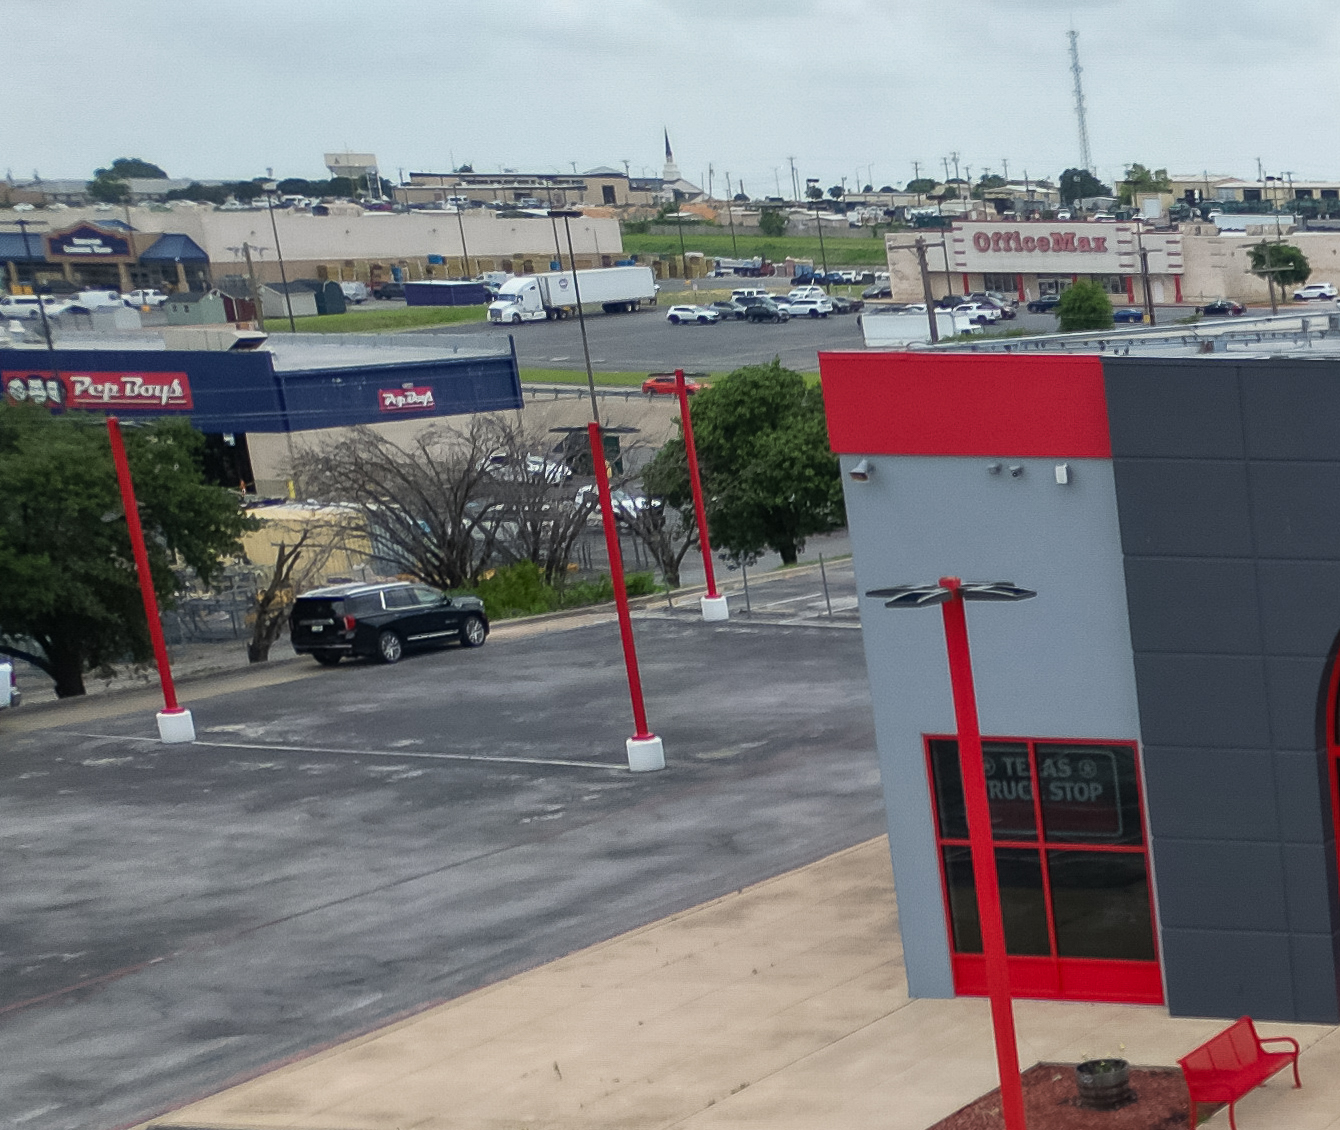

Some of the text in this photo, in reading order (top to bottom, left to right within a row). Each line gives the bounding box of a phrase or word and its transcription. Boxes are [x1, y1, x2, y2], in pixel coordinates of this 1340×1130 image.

[973, 230, 1109, 253] OfficeMax
[70, 376, 184, 405] Pep Boys
[1003, 757, 1072, 778] TEAS
[987, 780, 1102, 801] RUC STOP
